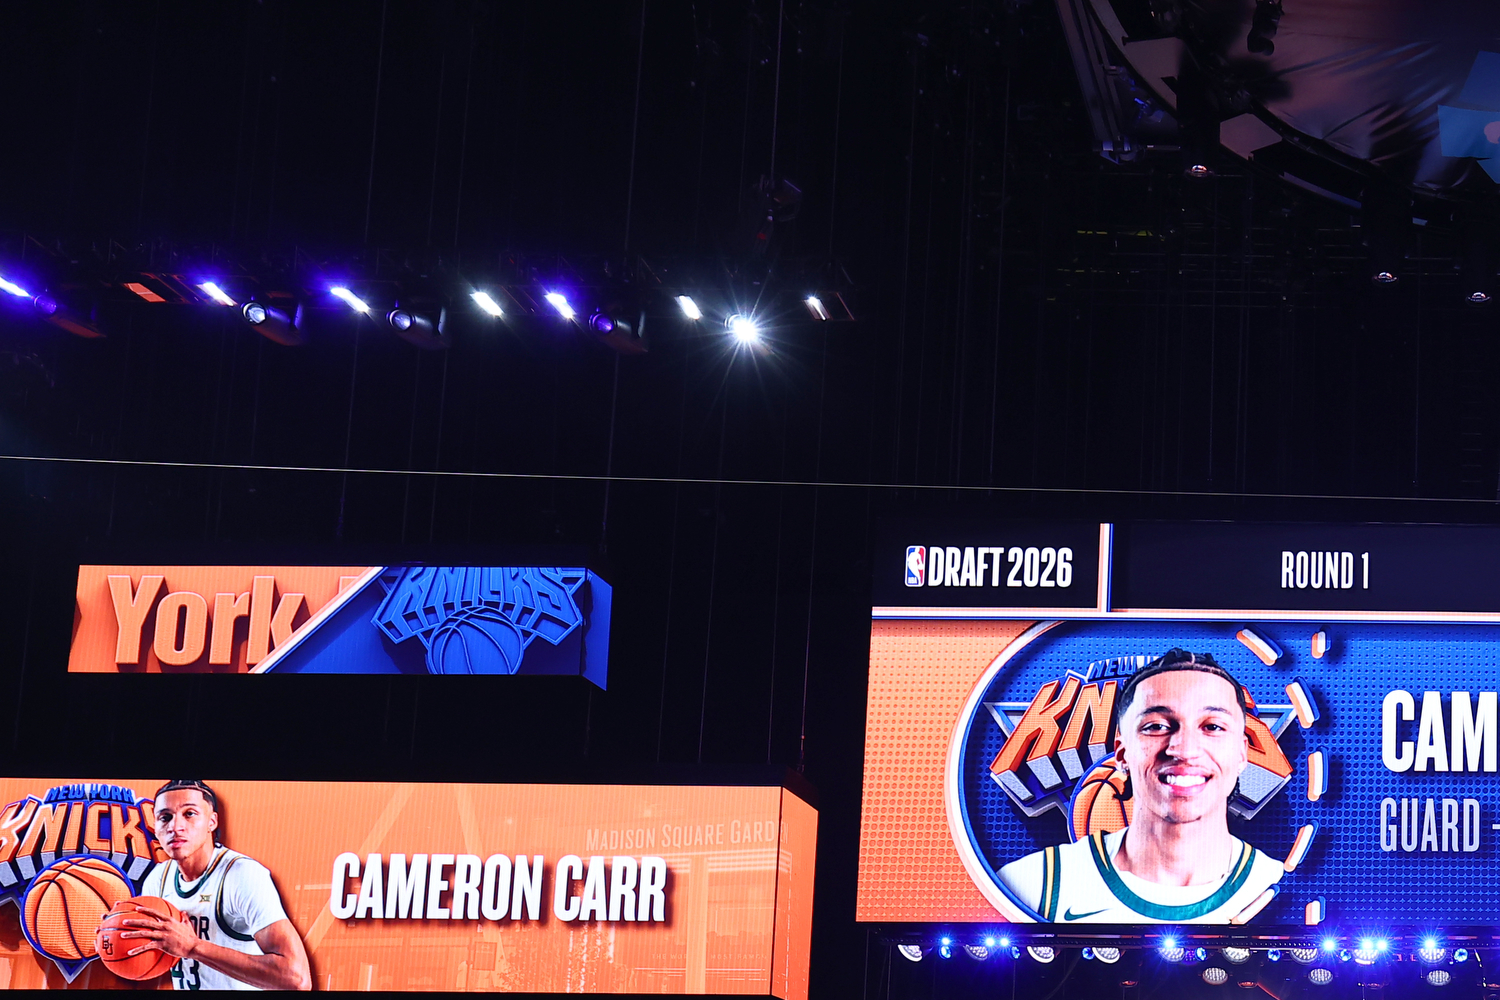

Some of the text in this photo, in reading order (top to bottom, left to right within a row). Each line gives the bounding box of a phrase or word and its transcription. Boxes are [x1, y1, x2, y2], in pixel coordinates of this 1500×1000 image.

[928, 546, 1073, 588] DRAFT 2026
[1281, 551, 1369, 589] ROUND 1
[47, 785, 134, 802] NEW YORK
[586, 828, 656, 851] MADISON
[661, 824, 725, 849] SQUARE
[1380, 797, 1481, 854] GUARD
[330, 853, 667, 923] CAMERON CARR
